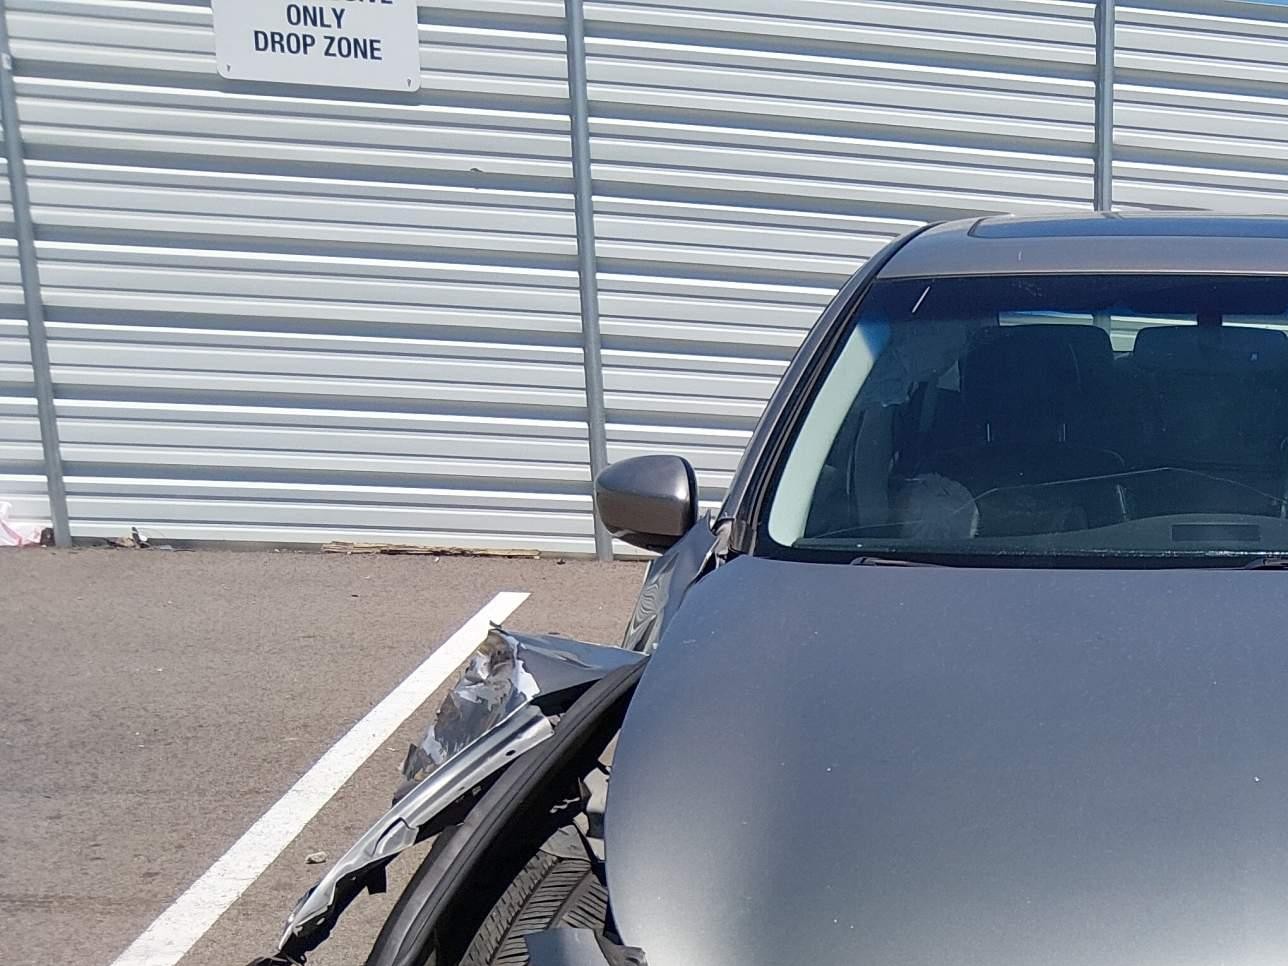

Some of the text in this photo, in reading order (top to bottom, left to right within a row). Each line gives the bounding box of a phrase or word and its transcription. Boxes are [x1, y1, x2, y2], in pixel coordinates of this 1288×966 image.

[286, 4, 345, 29] ONLY
[254, 30, 382, 60] DROP ZONE
